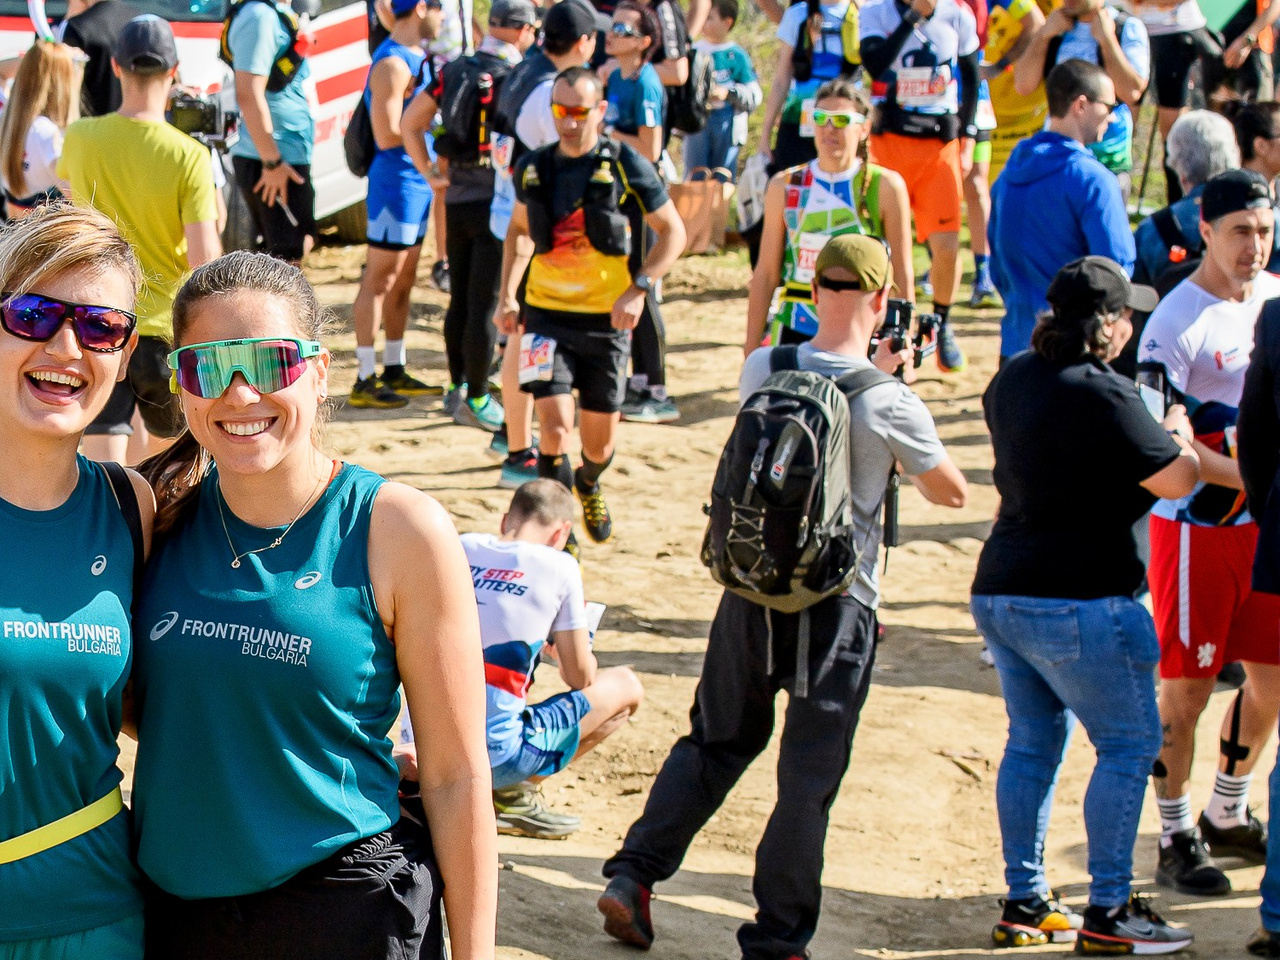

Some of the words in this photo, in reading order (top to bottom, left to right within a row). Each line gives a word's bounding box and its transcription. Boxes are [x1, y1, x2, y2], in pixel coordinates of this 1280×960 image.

[483, 568, 524, 580] STEP
[474, 579, 528, 596] ATTERS
[3, 620, 122, 645] FRONTRUNNER
[181, 619, 312, 655] FRONTRUNNER
[67, 638, 122, 657] BULGARIA
[241, 642, 308, 668] BULGARIA
